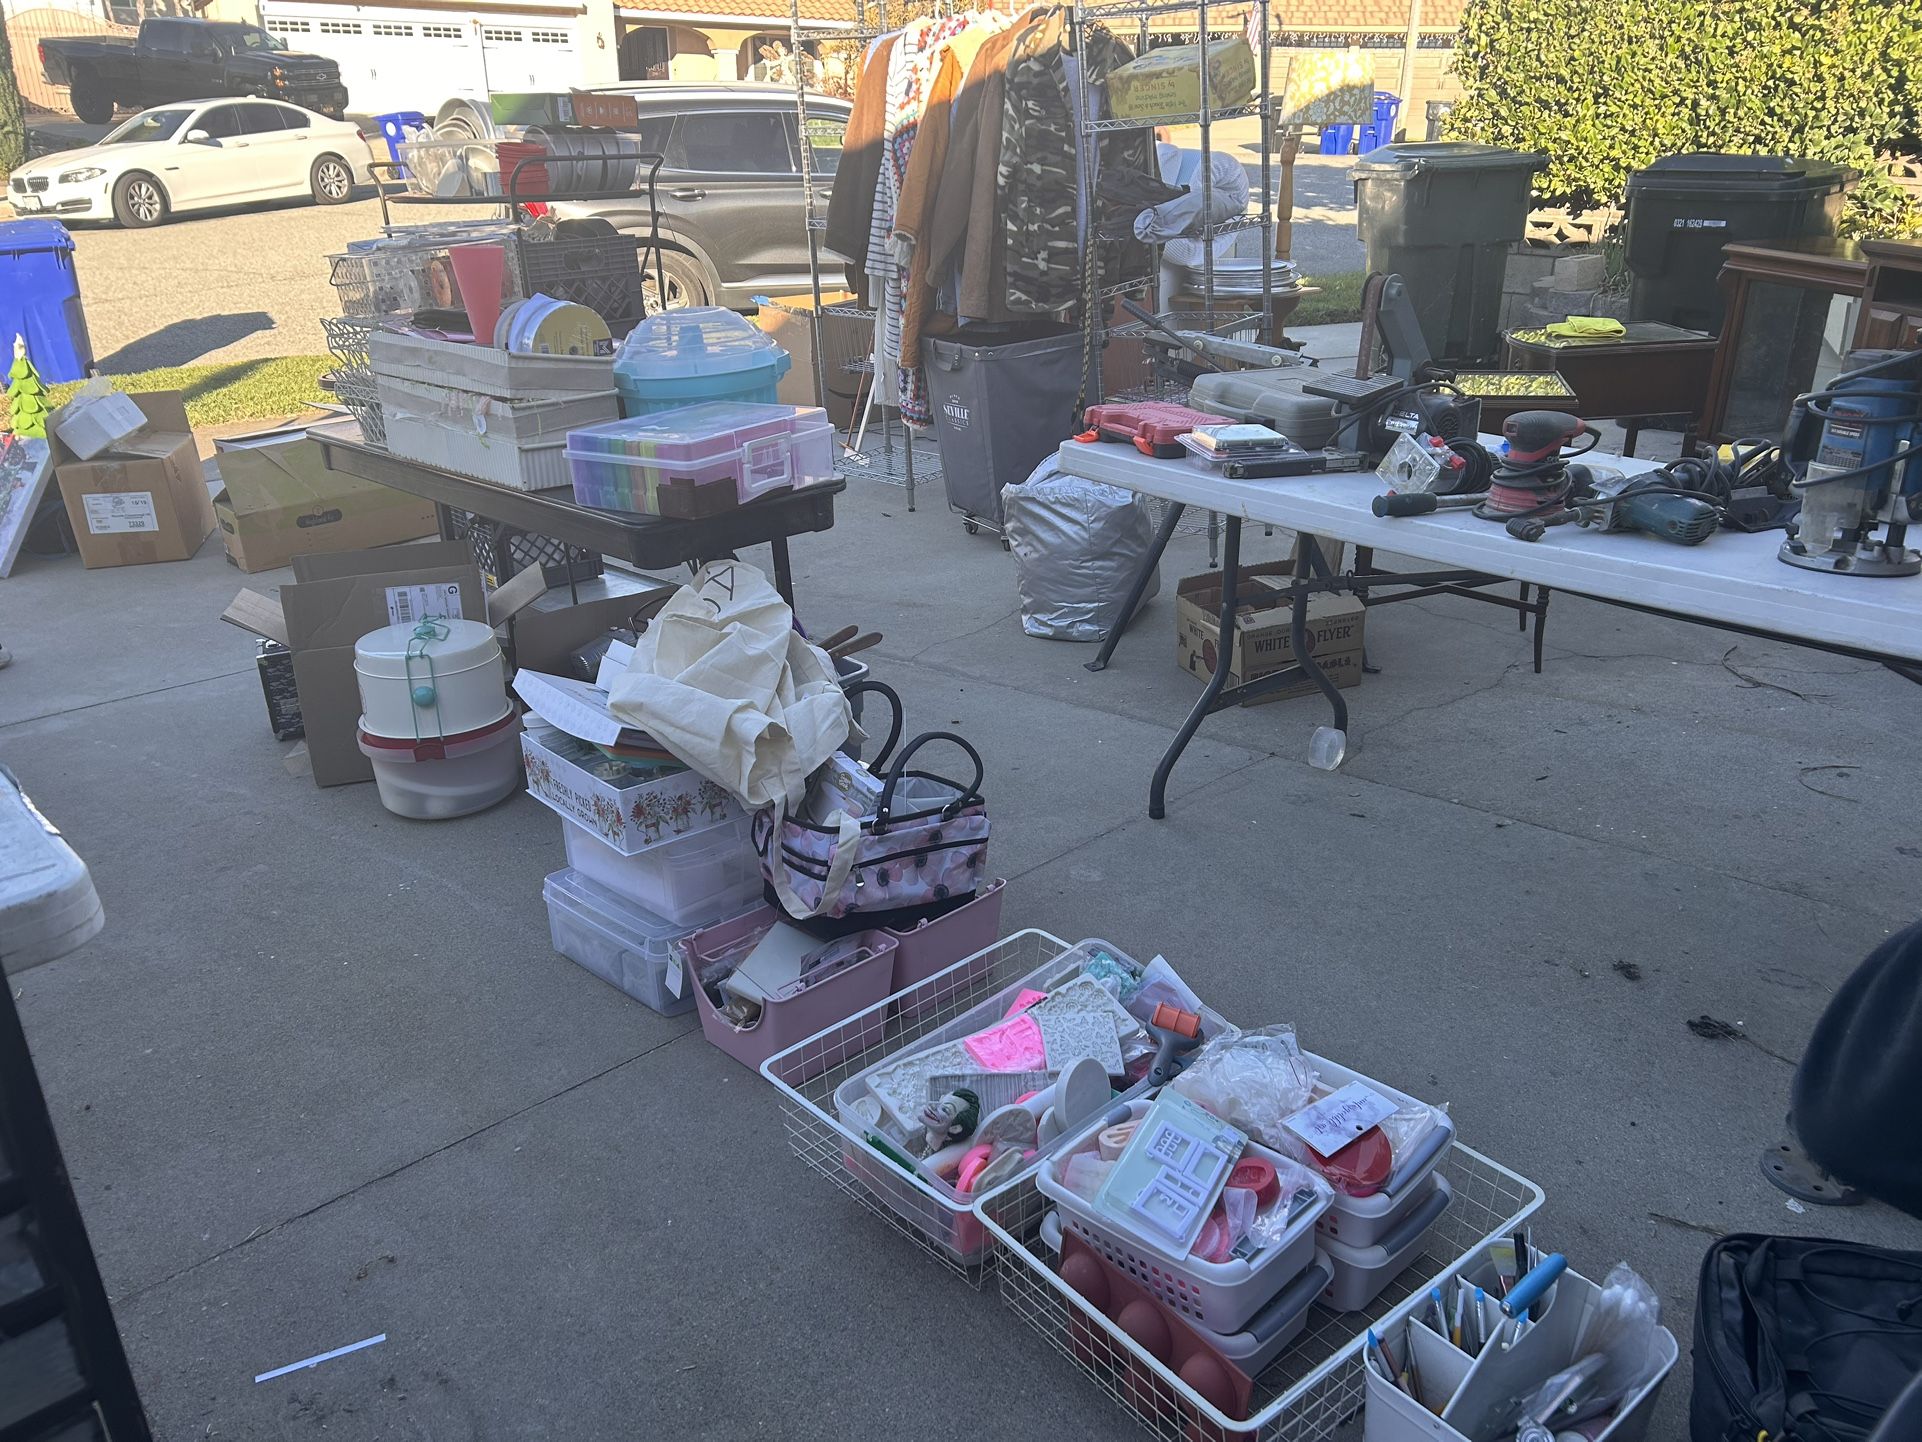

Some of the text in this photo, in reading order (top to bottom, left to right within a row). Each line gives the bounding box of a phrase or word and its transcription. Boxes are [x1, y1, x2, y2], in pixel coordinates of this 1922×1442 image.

[1133, 82, 1166, 92] SINGER
[943, 404, 970, 419] SEVILLE
[1254, 635, 1291, 654] WHITE
[552, 794, 575, 812] LOCALLY
